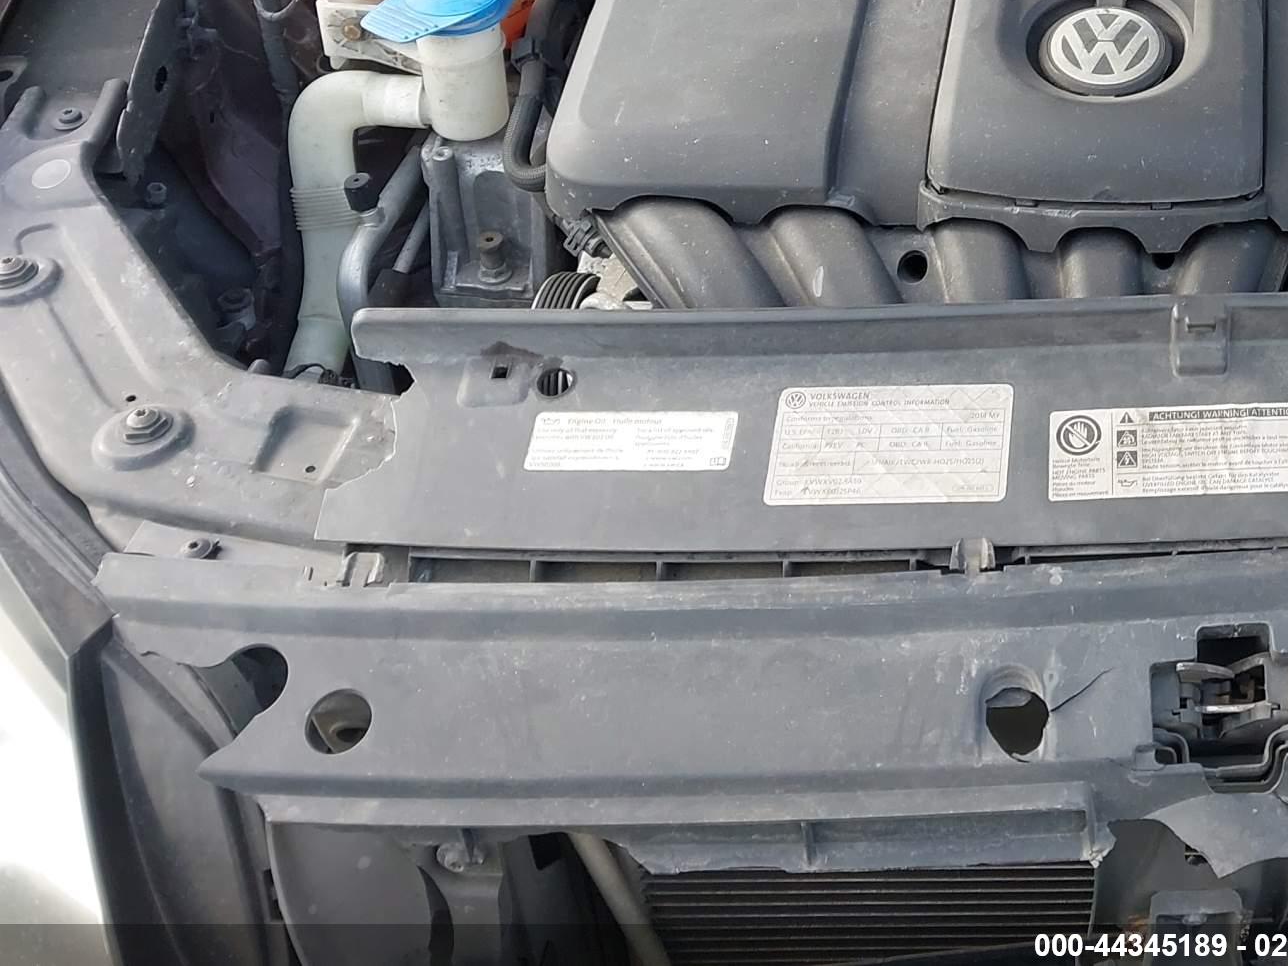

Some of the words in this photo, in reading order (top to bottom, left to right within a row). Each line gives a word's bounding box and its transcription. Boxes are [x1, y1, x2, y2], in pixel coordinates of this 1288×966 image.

[1051, 8, 1160, 83] VW
[810, 392, 870, 400] VOLKSWAGEN
[1153, 411, 1200, 420] ACHTUNG!
[1203, 410, 1248, 418] WARNING!
